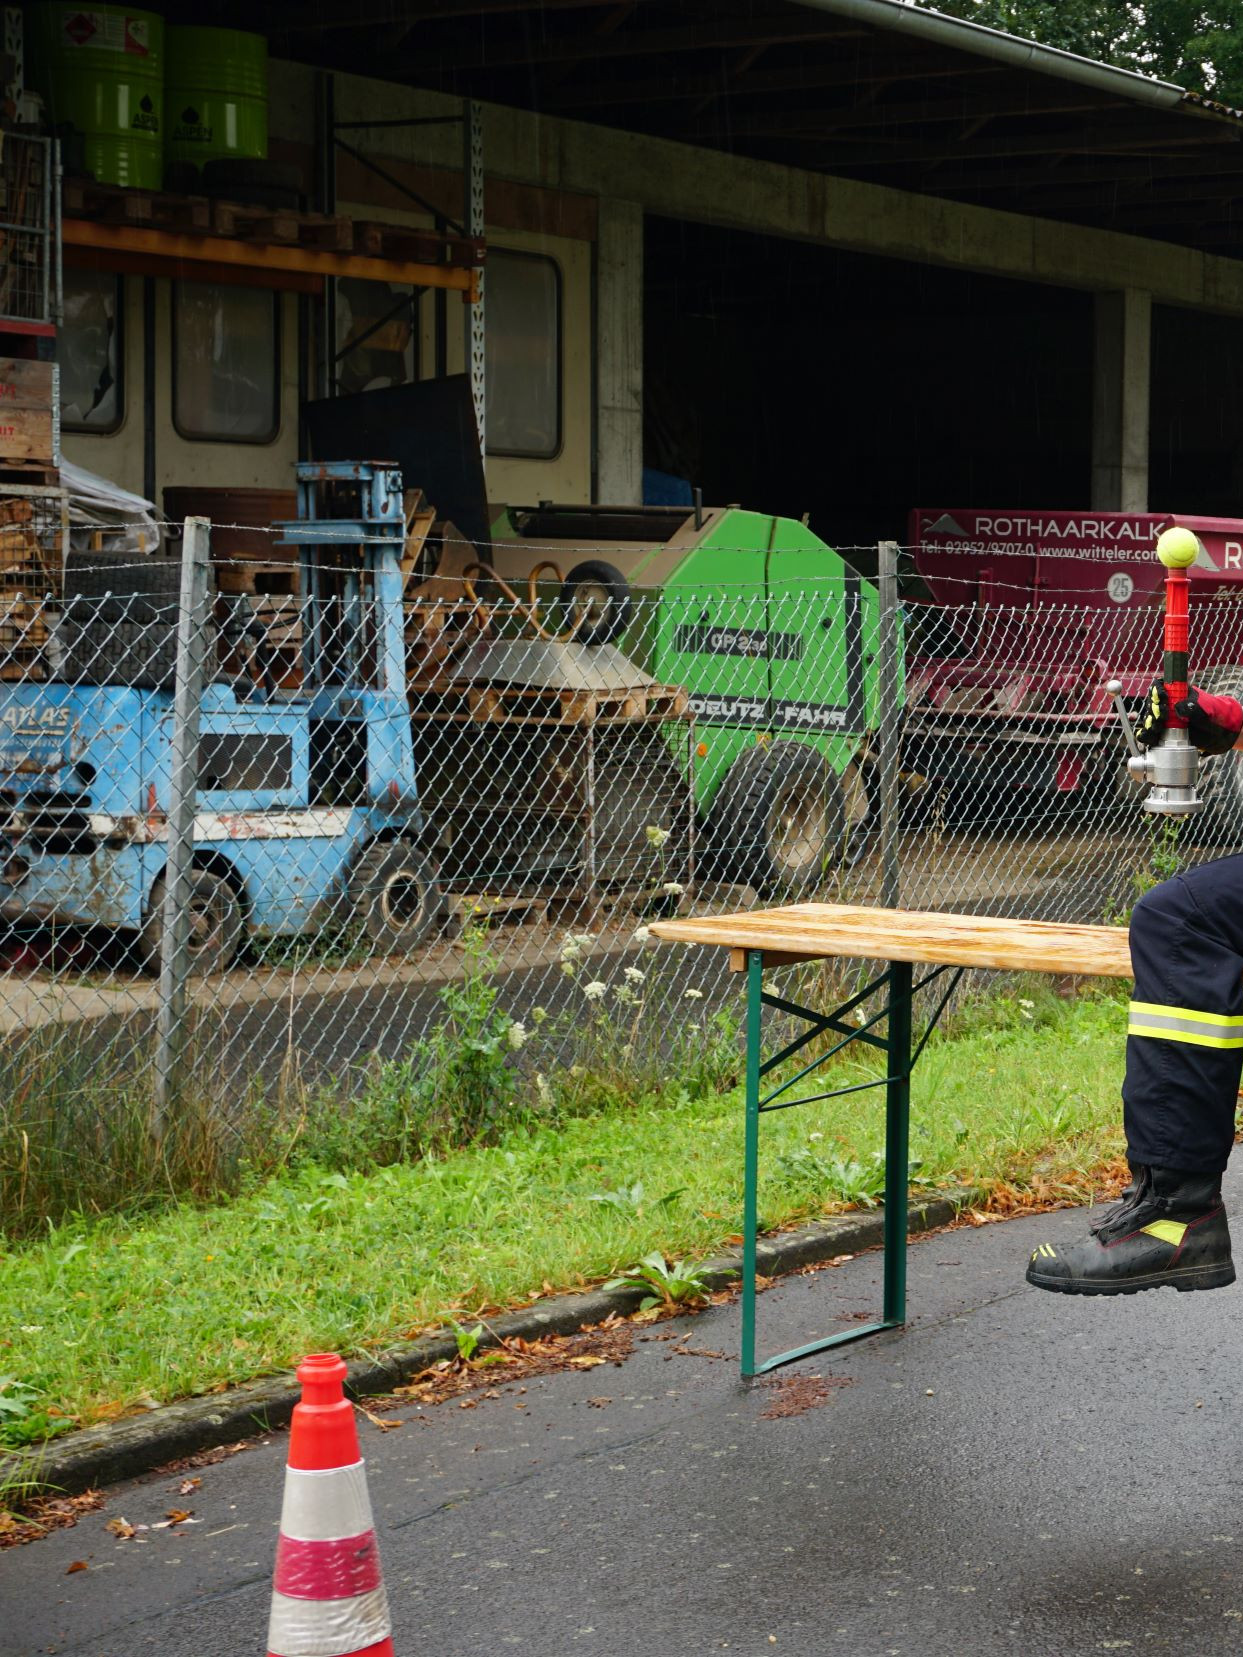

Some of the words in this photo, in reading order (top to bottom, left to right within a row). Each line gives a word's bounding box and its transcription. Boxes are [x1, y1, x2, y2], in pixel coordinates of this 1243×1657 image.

[975, 517, 1165, 541] ROTHAARKALK
[1113, 578, 1128, 598] 25
[2, 706, 70, 728] ATLAS
